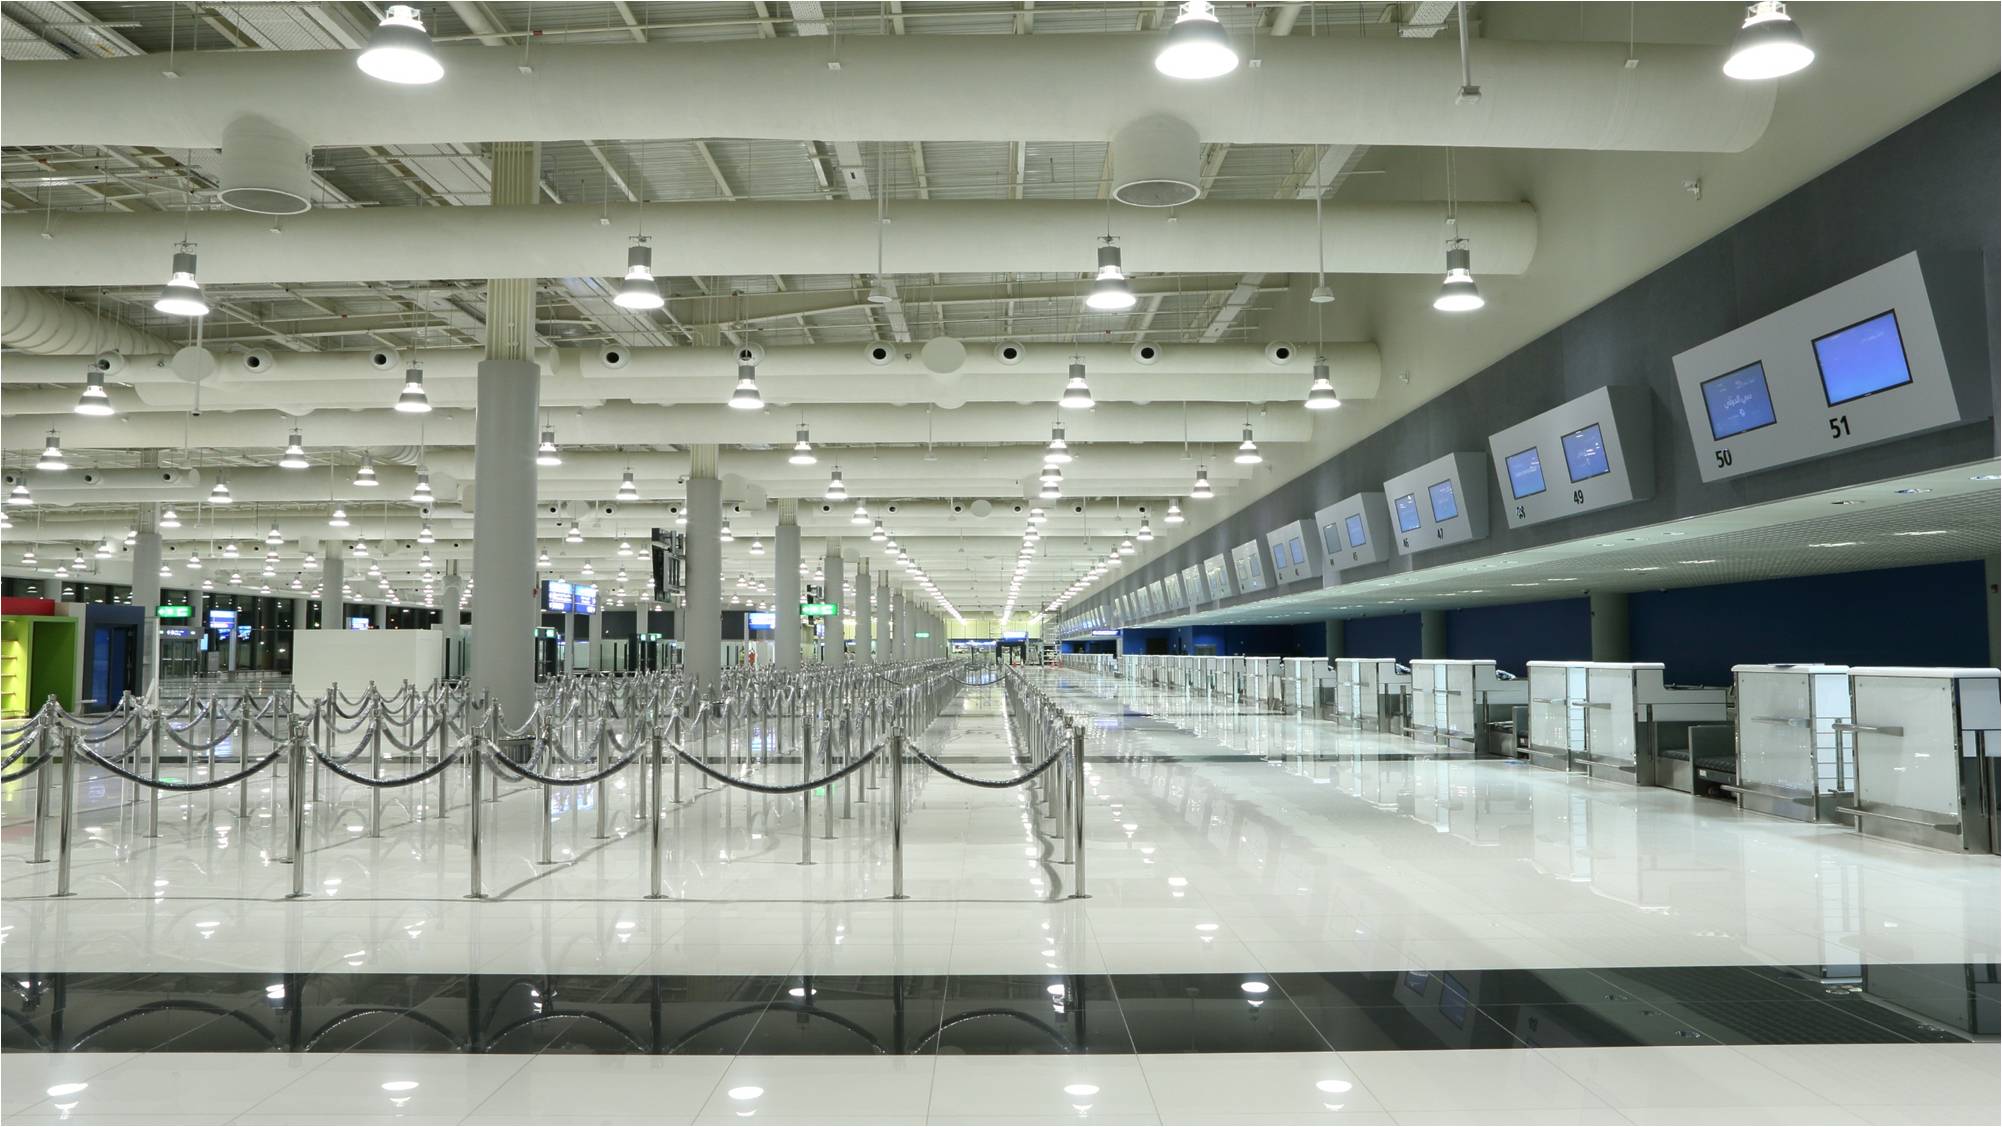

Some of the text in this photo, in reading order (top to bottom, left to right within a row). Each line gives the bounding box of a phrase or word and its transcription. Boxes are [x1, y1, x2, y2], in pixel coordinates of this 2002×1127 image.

[1829, 415, 1851, 439] 51
[1715, 448, 1733, 468] 50
[1573, 489, 1584, 504] 49
